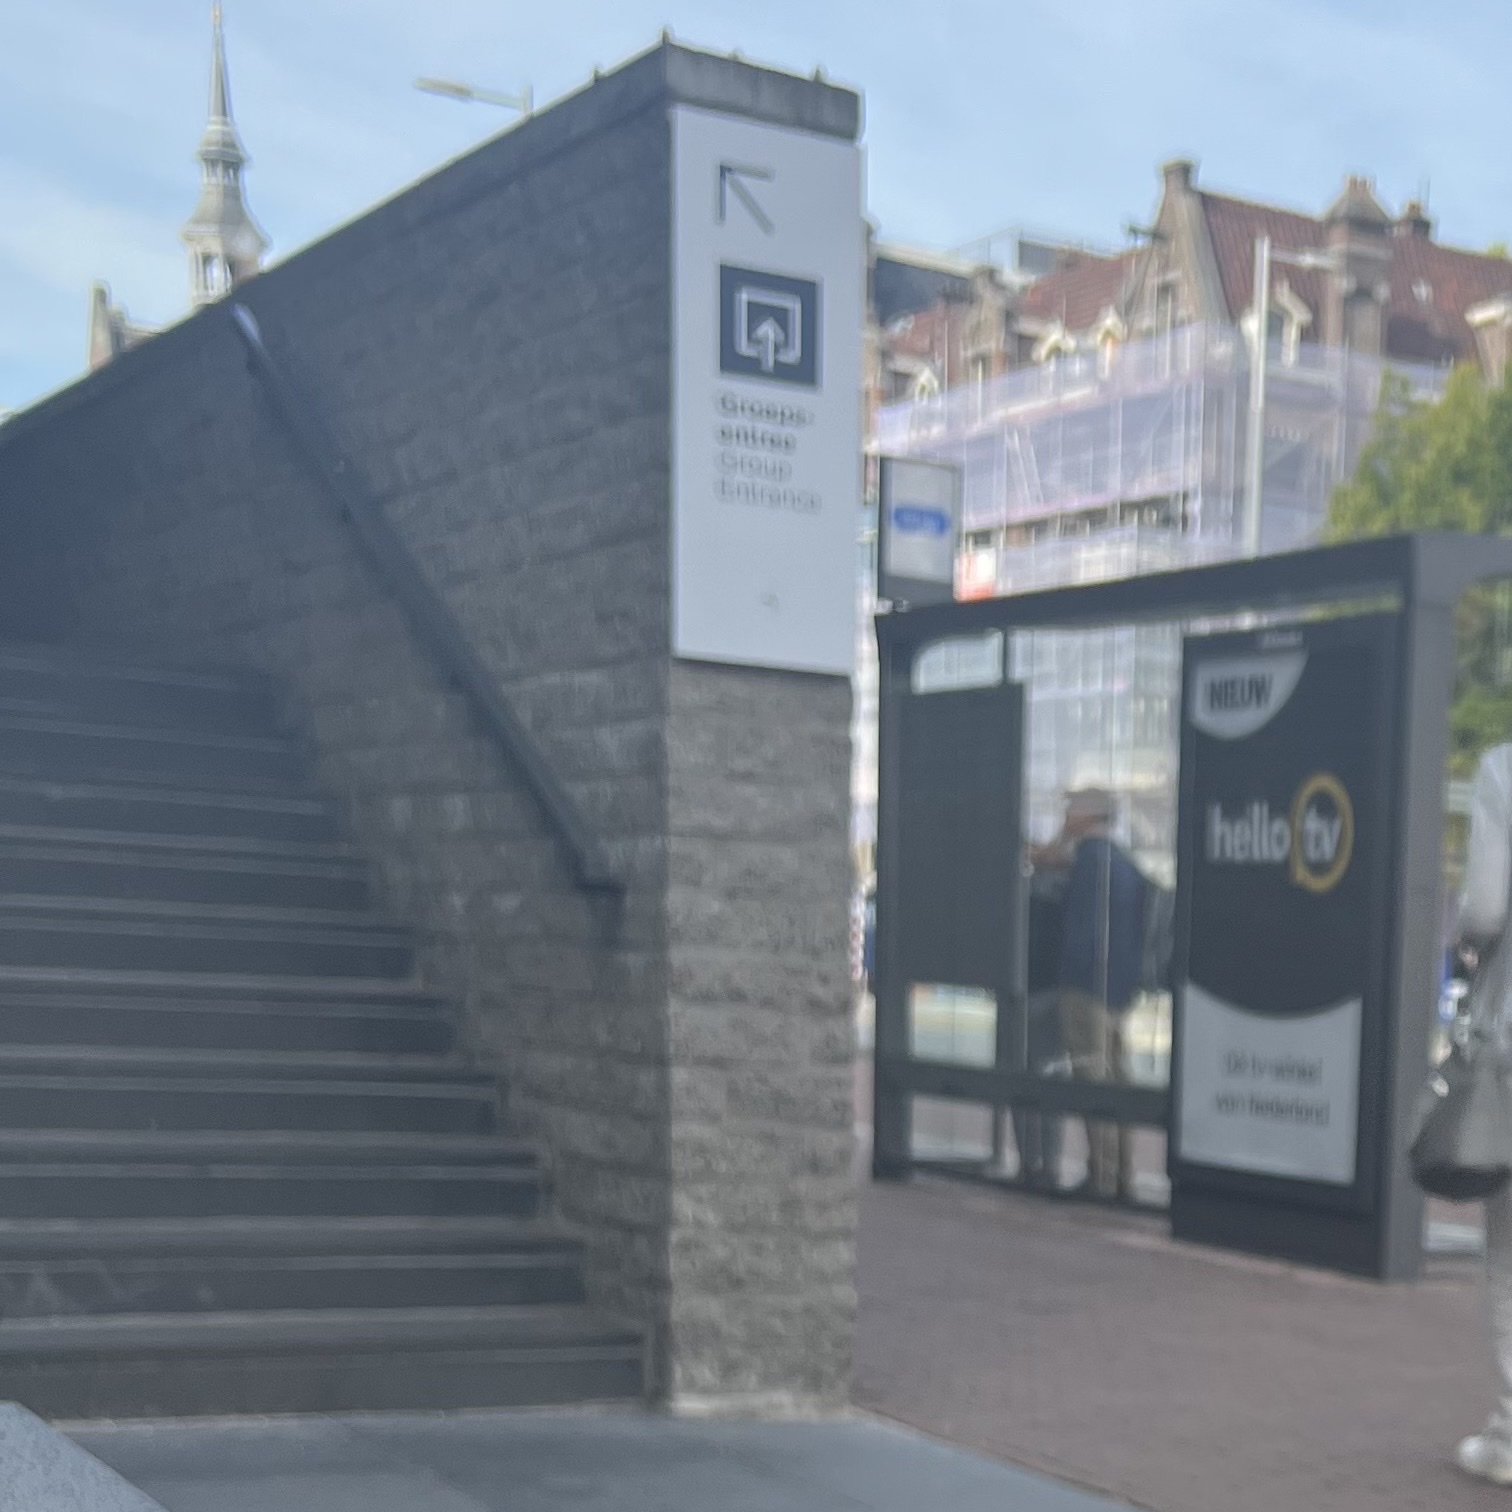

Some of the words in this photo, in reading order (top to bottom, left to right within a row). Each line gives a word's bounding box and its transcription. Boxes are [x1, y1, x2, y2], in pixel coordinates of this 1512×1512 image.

[718, 450, 793, 482] Group
[1209, 673, 1274, 711] NIEUW
[1208, 802, 1292, 862] hello
[1303, 803, 1343, 862] tv
